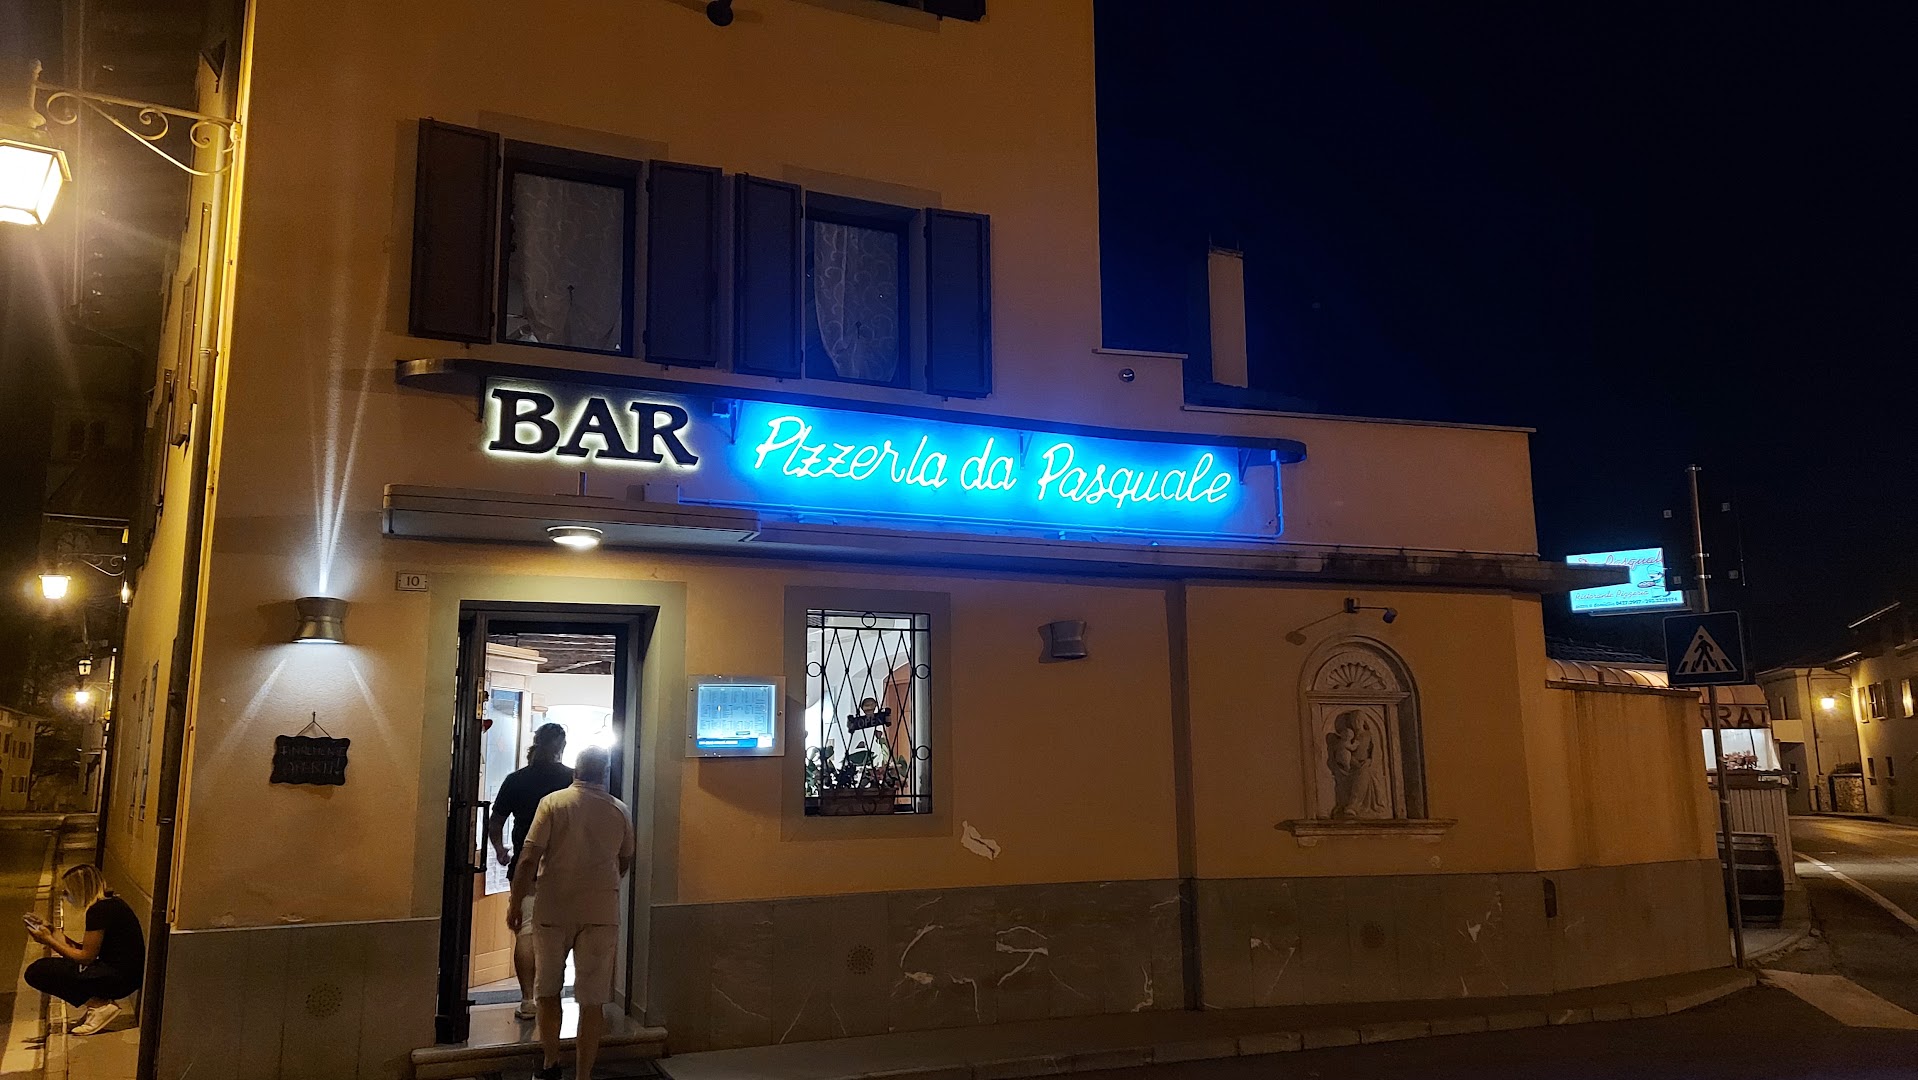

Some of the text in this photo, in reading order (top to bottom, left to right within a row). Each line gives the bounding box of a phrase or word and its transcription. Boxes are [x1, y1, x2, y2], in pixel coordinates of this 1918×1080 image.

[488, 388, 699, 466] BAR
[960, 436, 1017, 491] da
[1037, 442, 1232, 509] Pasquale
[406, 575, 420, 587] 10
